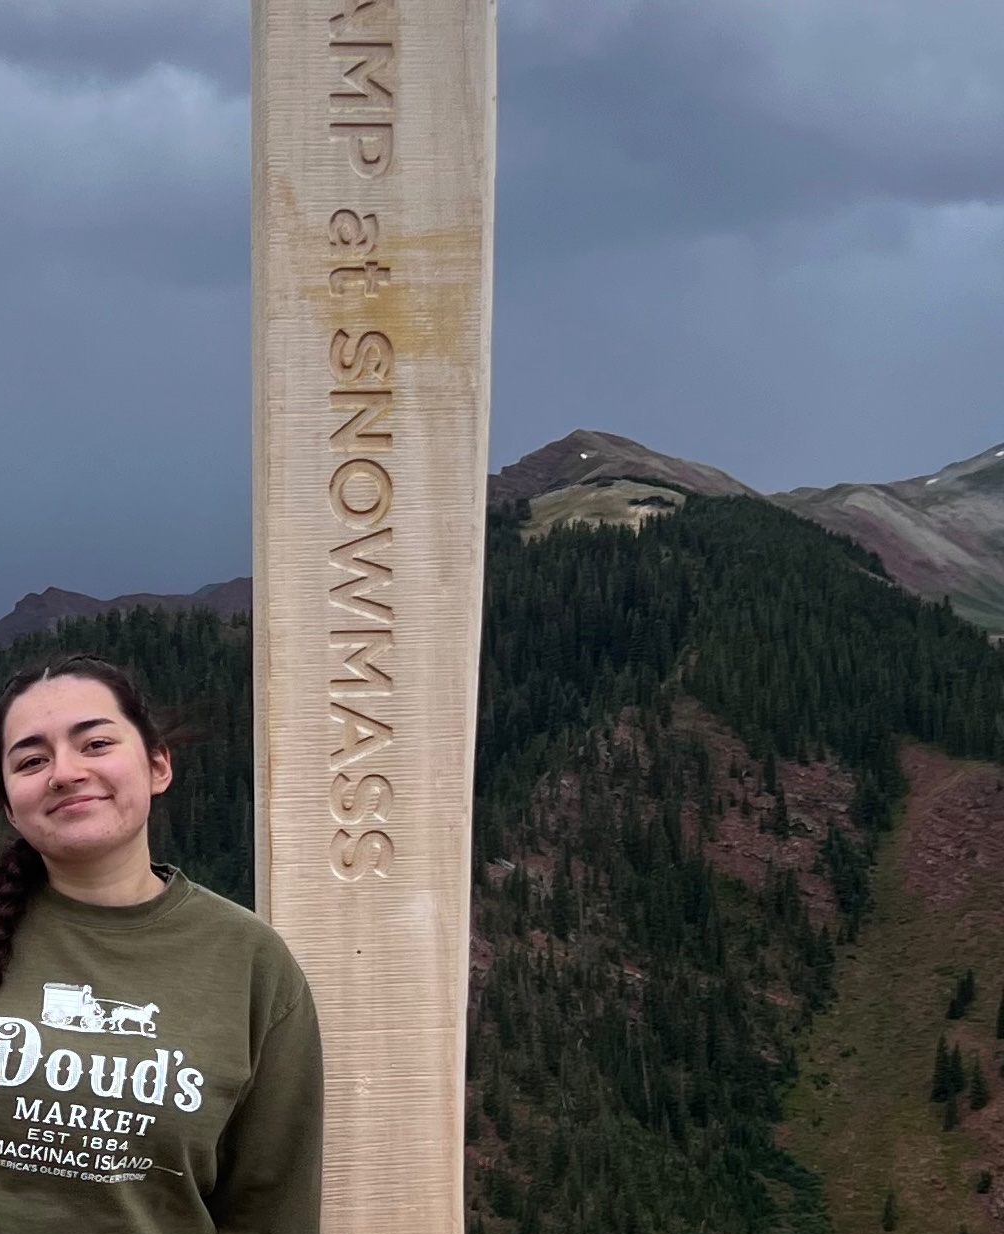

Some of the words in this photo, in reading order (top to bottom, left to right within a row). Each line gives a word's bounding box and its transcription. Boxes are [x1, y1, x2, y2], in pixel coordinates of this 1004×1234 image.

[328, 208, 391, 298] at
[328, 328, 394, 881] SNOWMASS
[12, 1096, 156, 1137] MARKET
[27, 1127, 71, 1145] EST
[81, 1135, 129, 1152] 1884
[39, 1165, 79, 1179] OLDEST
[80, 1171, 123, 1184] GROCER
[94, 1153, 154, 1171] ISLAND
